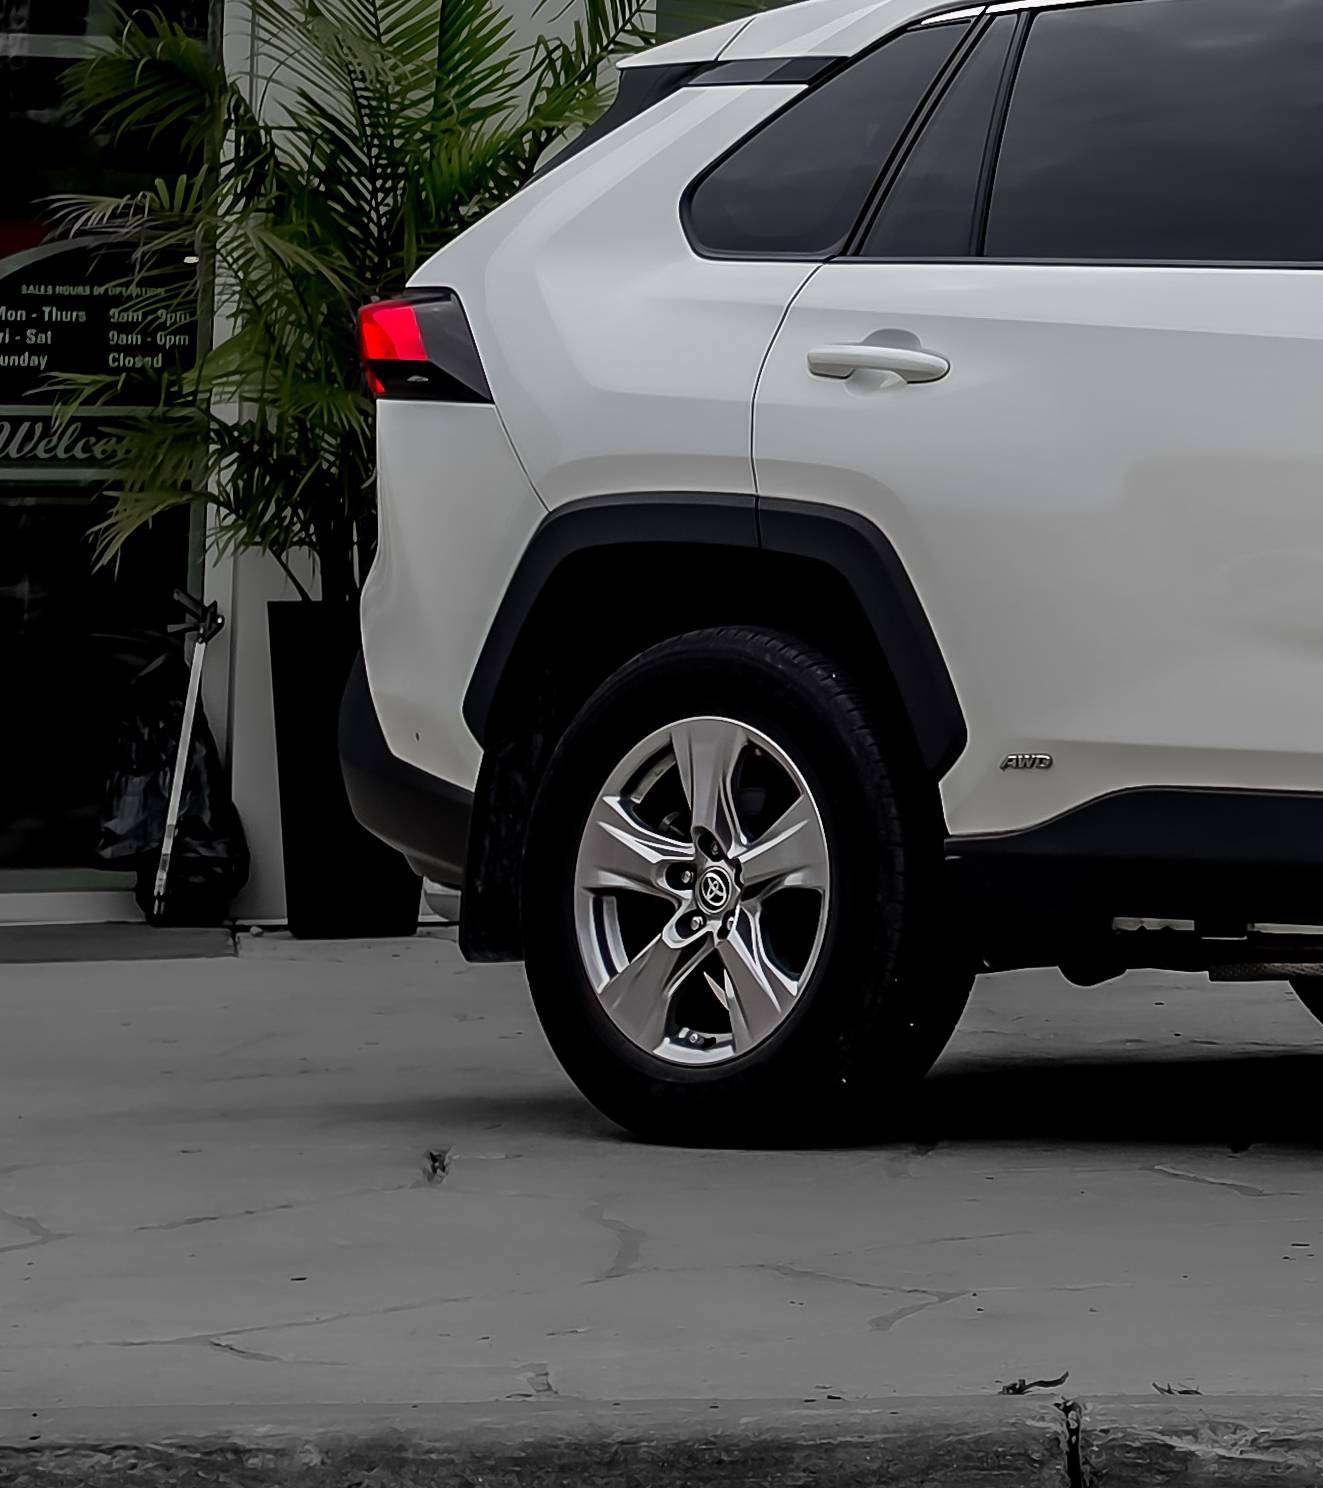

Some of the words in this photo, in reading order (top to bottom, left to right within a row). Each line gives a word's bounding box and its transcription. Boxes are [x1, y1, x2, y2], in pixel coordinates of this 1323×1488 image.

[42, 305, 87, 322] Thurs
[26, 328, 52, 344] Sat
[109, 330, 142, 345] 9am
[0, 350, 48, 370] unday
[109, 352, 163, 369] Closed
[1000, 753, 1053, 771] AWD
